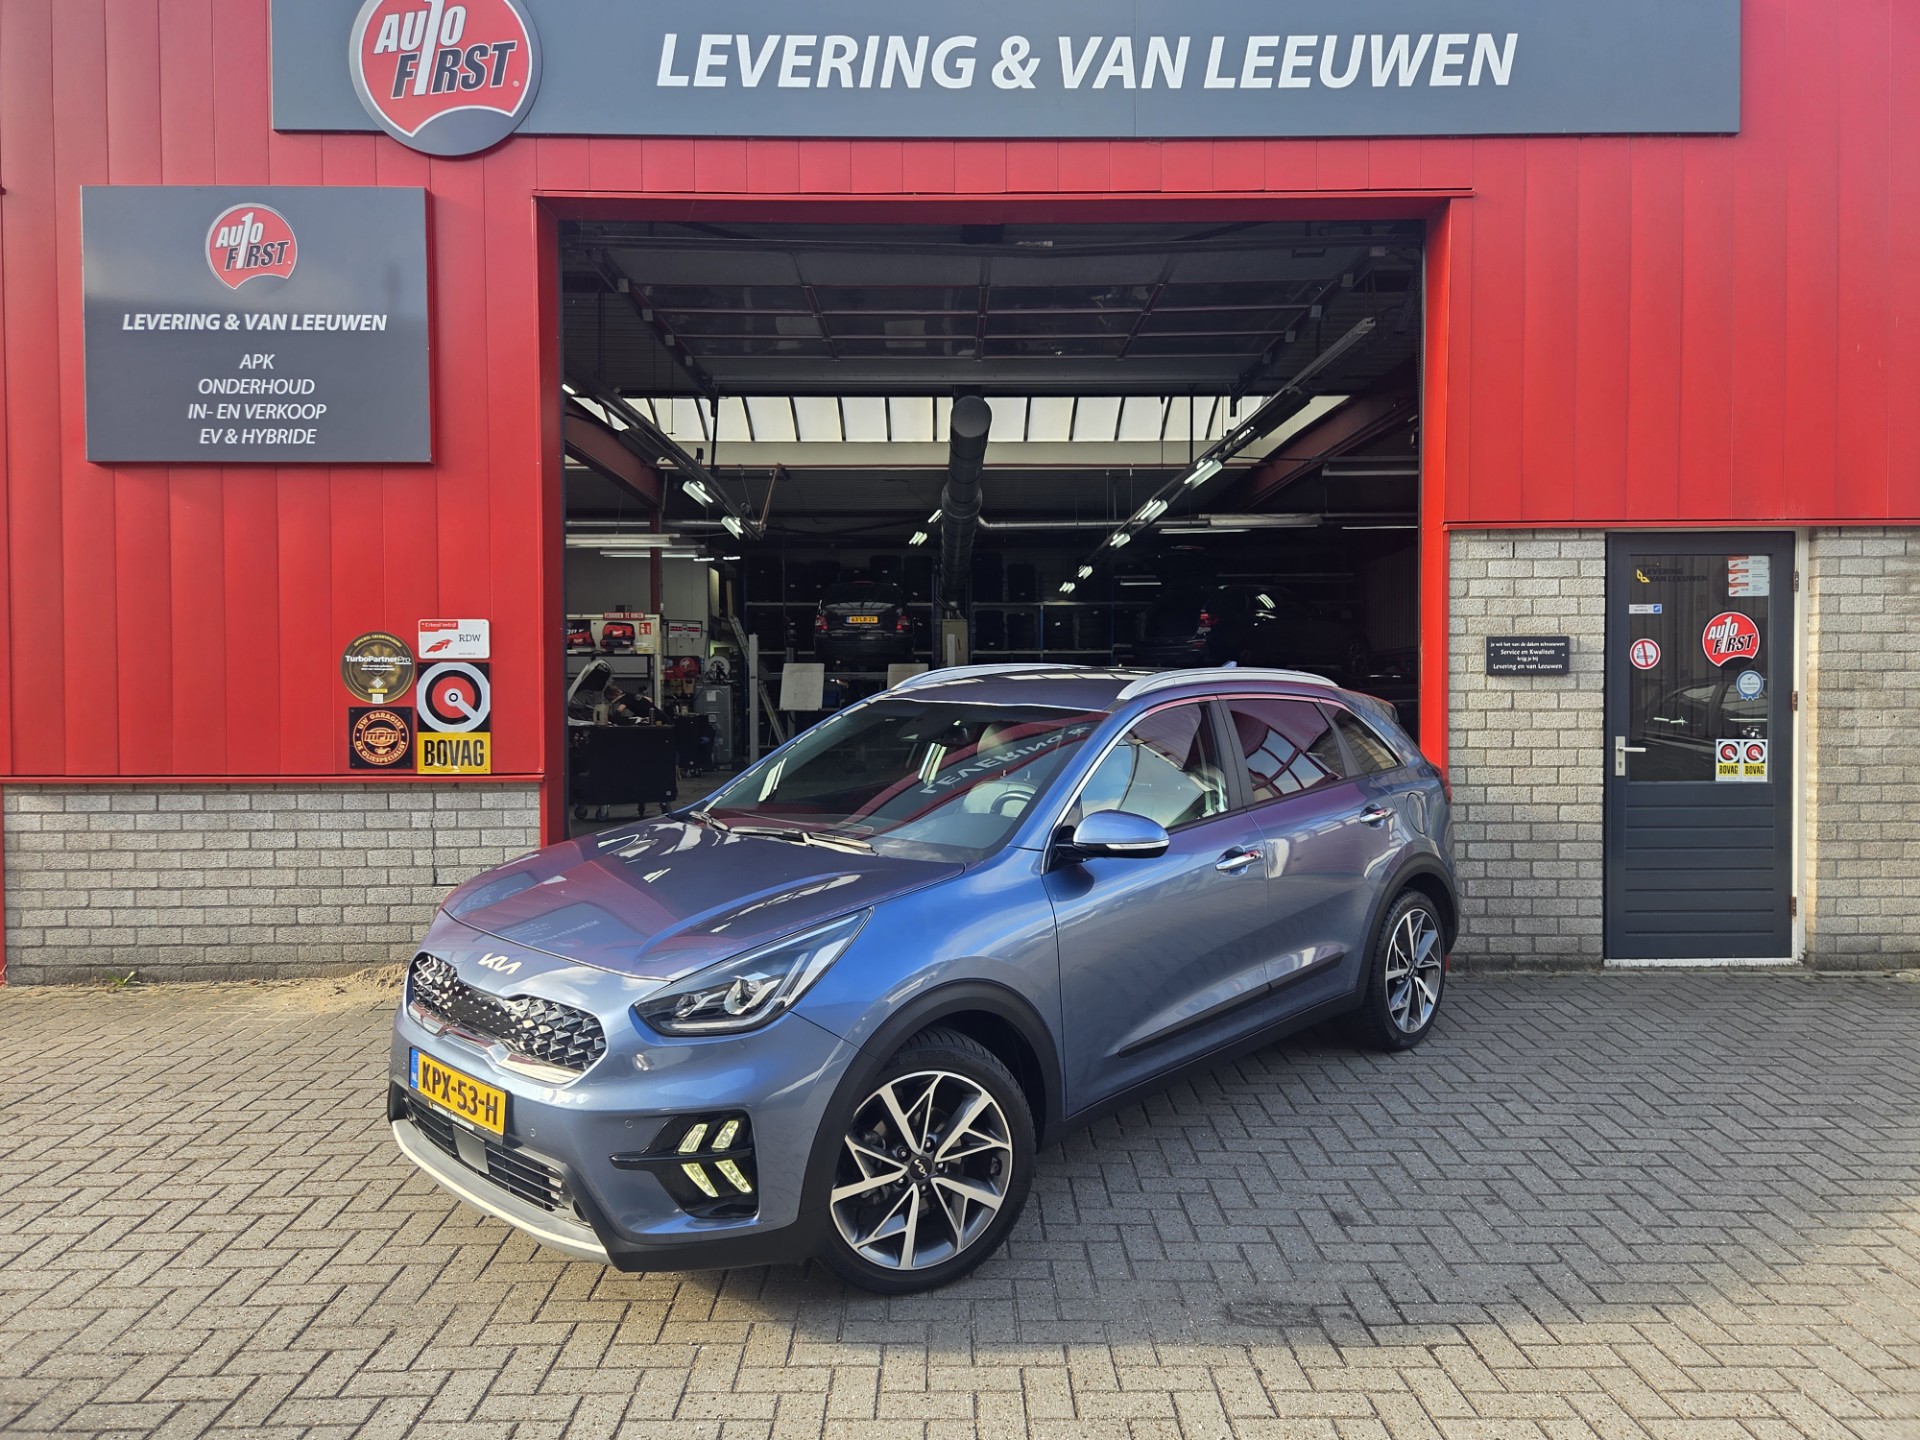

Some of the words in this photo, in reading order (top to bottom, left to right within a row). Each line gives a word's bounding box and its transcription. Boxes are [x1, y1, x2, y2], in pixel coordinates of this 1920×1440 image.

[655, 33, 977, 89] LEVERING
[991, 34, 1042, 89] &
[1059, 34, 1191, 89] VAN
[1204, 32, 1519, 89] LEEUWEN
[390, 40, 518, 100] FIRST
[224, 240, 291, 271] FIRST
[122, 313, 221, 330] LEVERING
[224, 313, 241, 330] &
[244, 314, 287, 331] VAN
[291, 314, 388, 331] LEEUWEN
[239, 353, 275, 369] APK
[197, 378, 316, 394] ONDERHOUD
[187, 403, 214, 419] IN-
[216, 404, 241, 419] EN
[244, 404, 327, 419] VERKOOP
[199, 429, 223, 444] EV
[224, 429, 239, 444] &
[241, 429, 318, 444] HYBRIDE
[459, 634, 481, 642] RDW
[1712, 634, 1756, 655] FIRST
[345, 655, 411, 663] TurboPartnerPro
[357, 717, 369, 730] UW
[369, 712, 404, 730] GARAGIST
[355, 740, 363, 751] DE
[361, 741, 407, 763] OLIESPECIALIST
[424, 739, 484, 766] BOVAG
[1719, 765, 1739, 775] BOVAG
[1744, 765, 1765, 775] BOVAG
[478, 952, 523, 975] KIA
[422, 1061, 499, 1126] KPX-53-H
